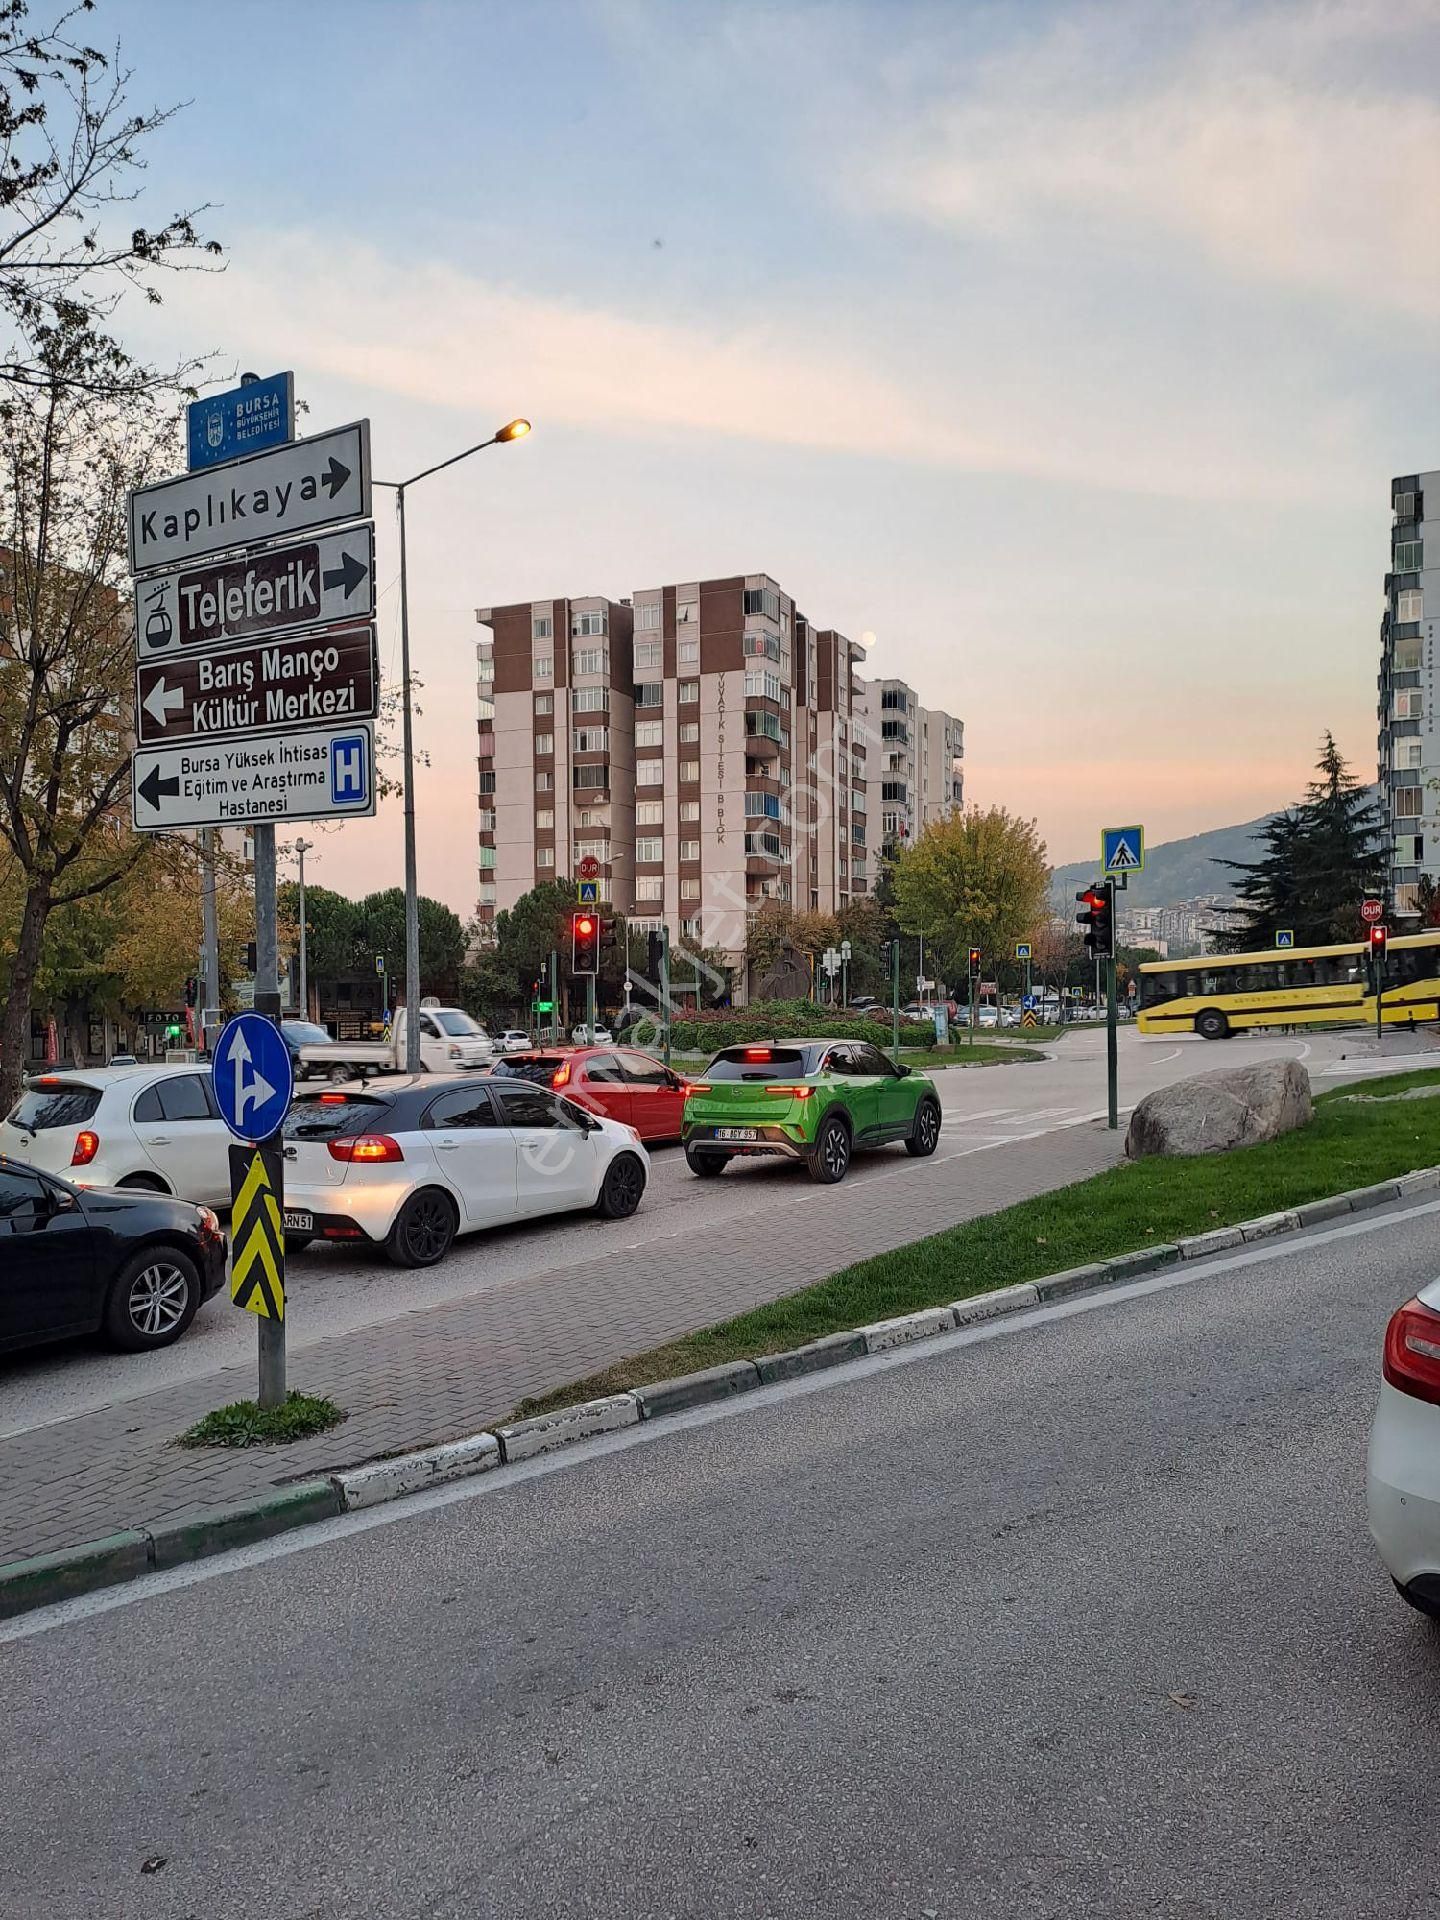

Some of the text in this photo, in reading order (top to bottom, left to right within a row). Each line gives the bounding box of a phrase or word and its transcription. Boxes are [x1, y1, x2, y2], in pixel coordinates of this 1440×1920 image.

[236, 393, 279, 417] BURSA
[236, 417, 280, 440] BELEDİYESİ
[141, 475, 317, 544] Kaplıkaya
[181, 560, 318, 630] Teleferik
[199, 647, 339, 691] Barış Manço
[192, 678, 355, 732] Kültür Merkezi
[181, 741, 328, 775] Bursa Yüksek İhtisas
[336, 748, 361, 792] H
[184, 770, 325, 801] Eğitim ve Araştırma
[717, 794, 724, 803] B
[219, 795, 288, 817] Hastanesi
[717, 808, 725, 844] BLOK
[581, 863, 599, 873] DUR
[1363, 905, 1382, 915] DUR
[147, 1013, 180, 1022] FOTO
[719, 1129, 726, 1138] 16
[744, 1130, 757, 1139] 957
